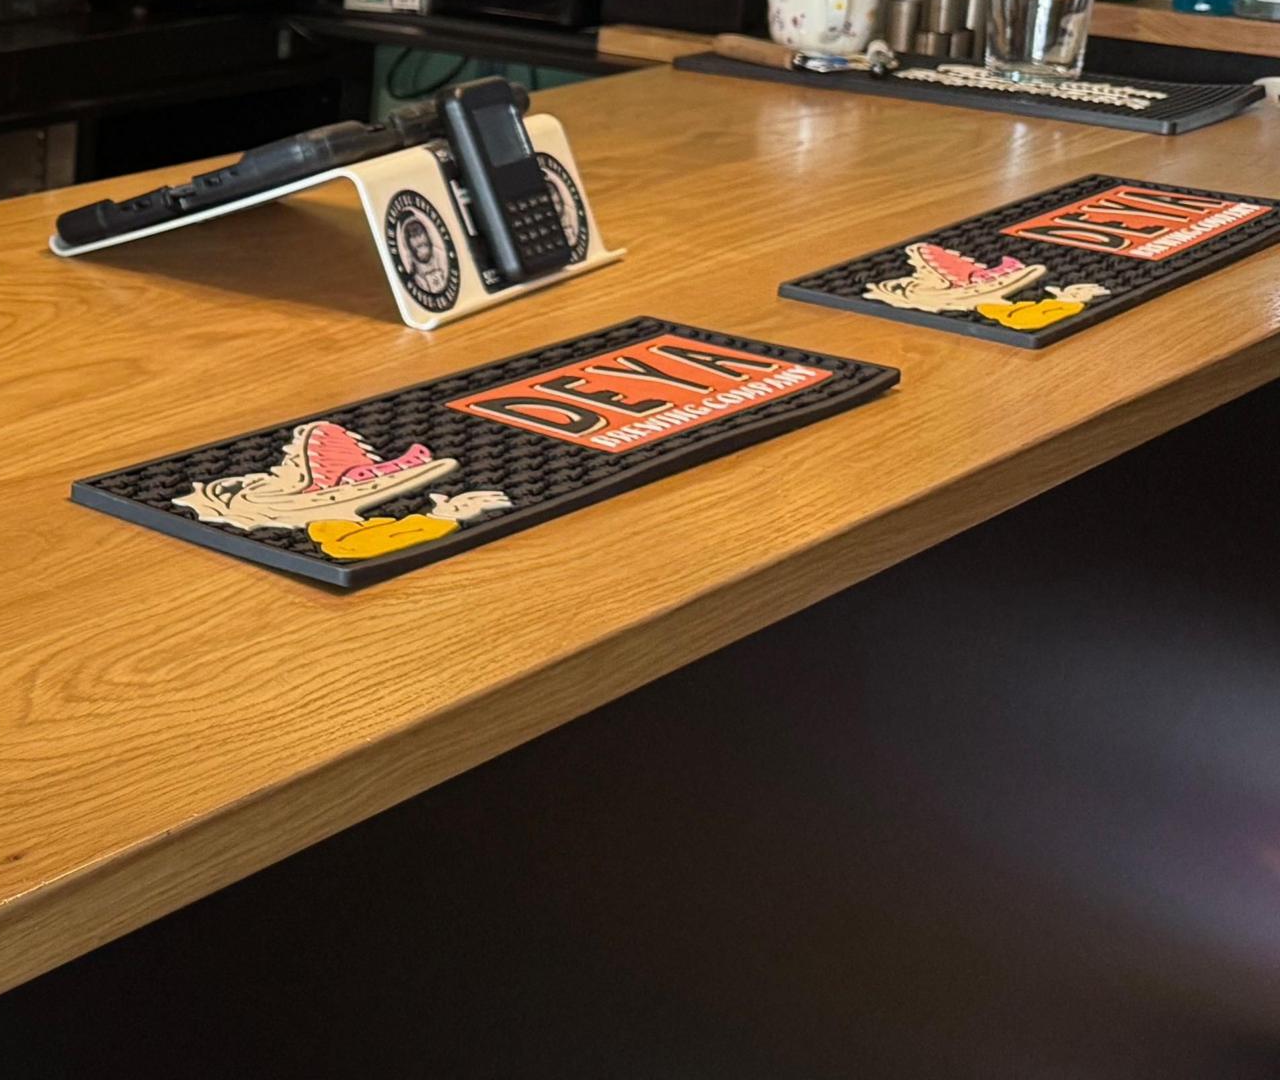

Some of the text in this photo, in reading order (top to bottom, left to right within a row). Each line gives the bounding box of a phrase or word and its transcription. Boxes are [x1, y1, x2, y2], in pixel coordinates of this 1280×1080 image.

[1016, 191, 1228, 253] DEYA
[469, 345, 779, 437] DEYA
[590, 364, 819, 450] BREWING COMPANY
